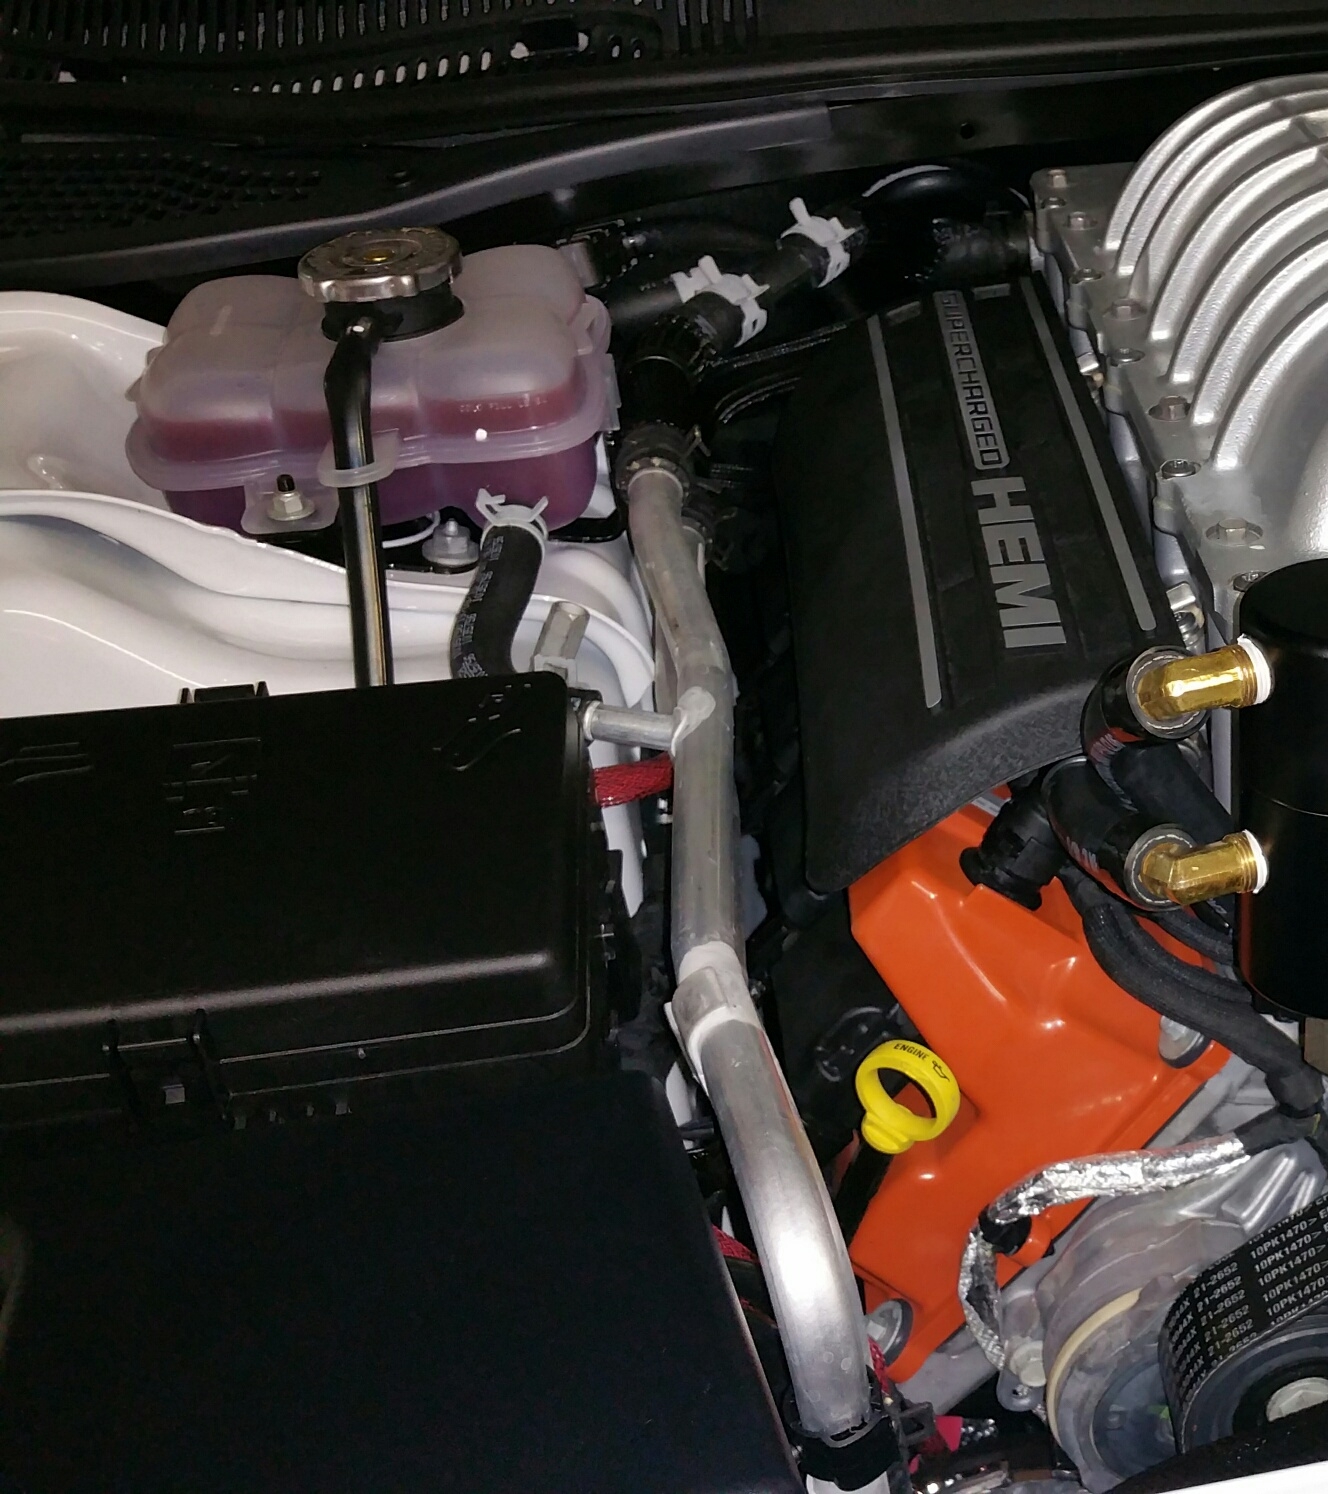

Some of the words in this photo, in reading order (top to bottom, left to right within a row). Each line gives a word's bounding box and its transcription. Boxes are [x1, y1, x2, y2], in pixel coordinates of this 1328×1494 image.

[942, 291, 1003, 467] SUPERCHARGED
[970, 476, 1067, 649] HEMI
[893, 1043, 929, 1060] ENGINE
[1193, 1262, 1238, 1299] 21-2652
[1197, 1275, 1242, 1312] 21-2652
[1200, 1289, 1246, 1326] 21-2652
[1204, 1304, 1250, 1343] 21-2652
[1208, 1319, 1254, 1357] 21-2652
